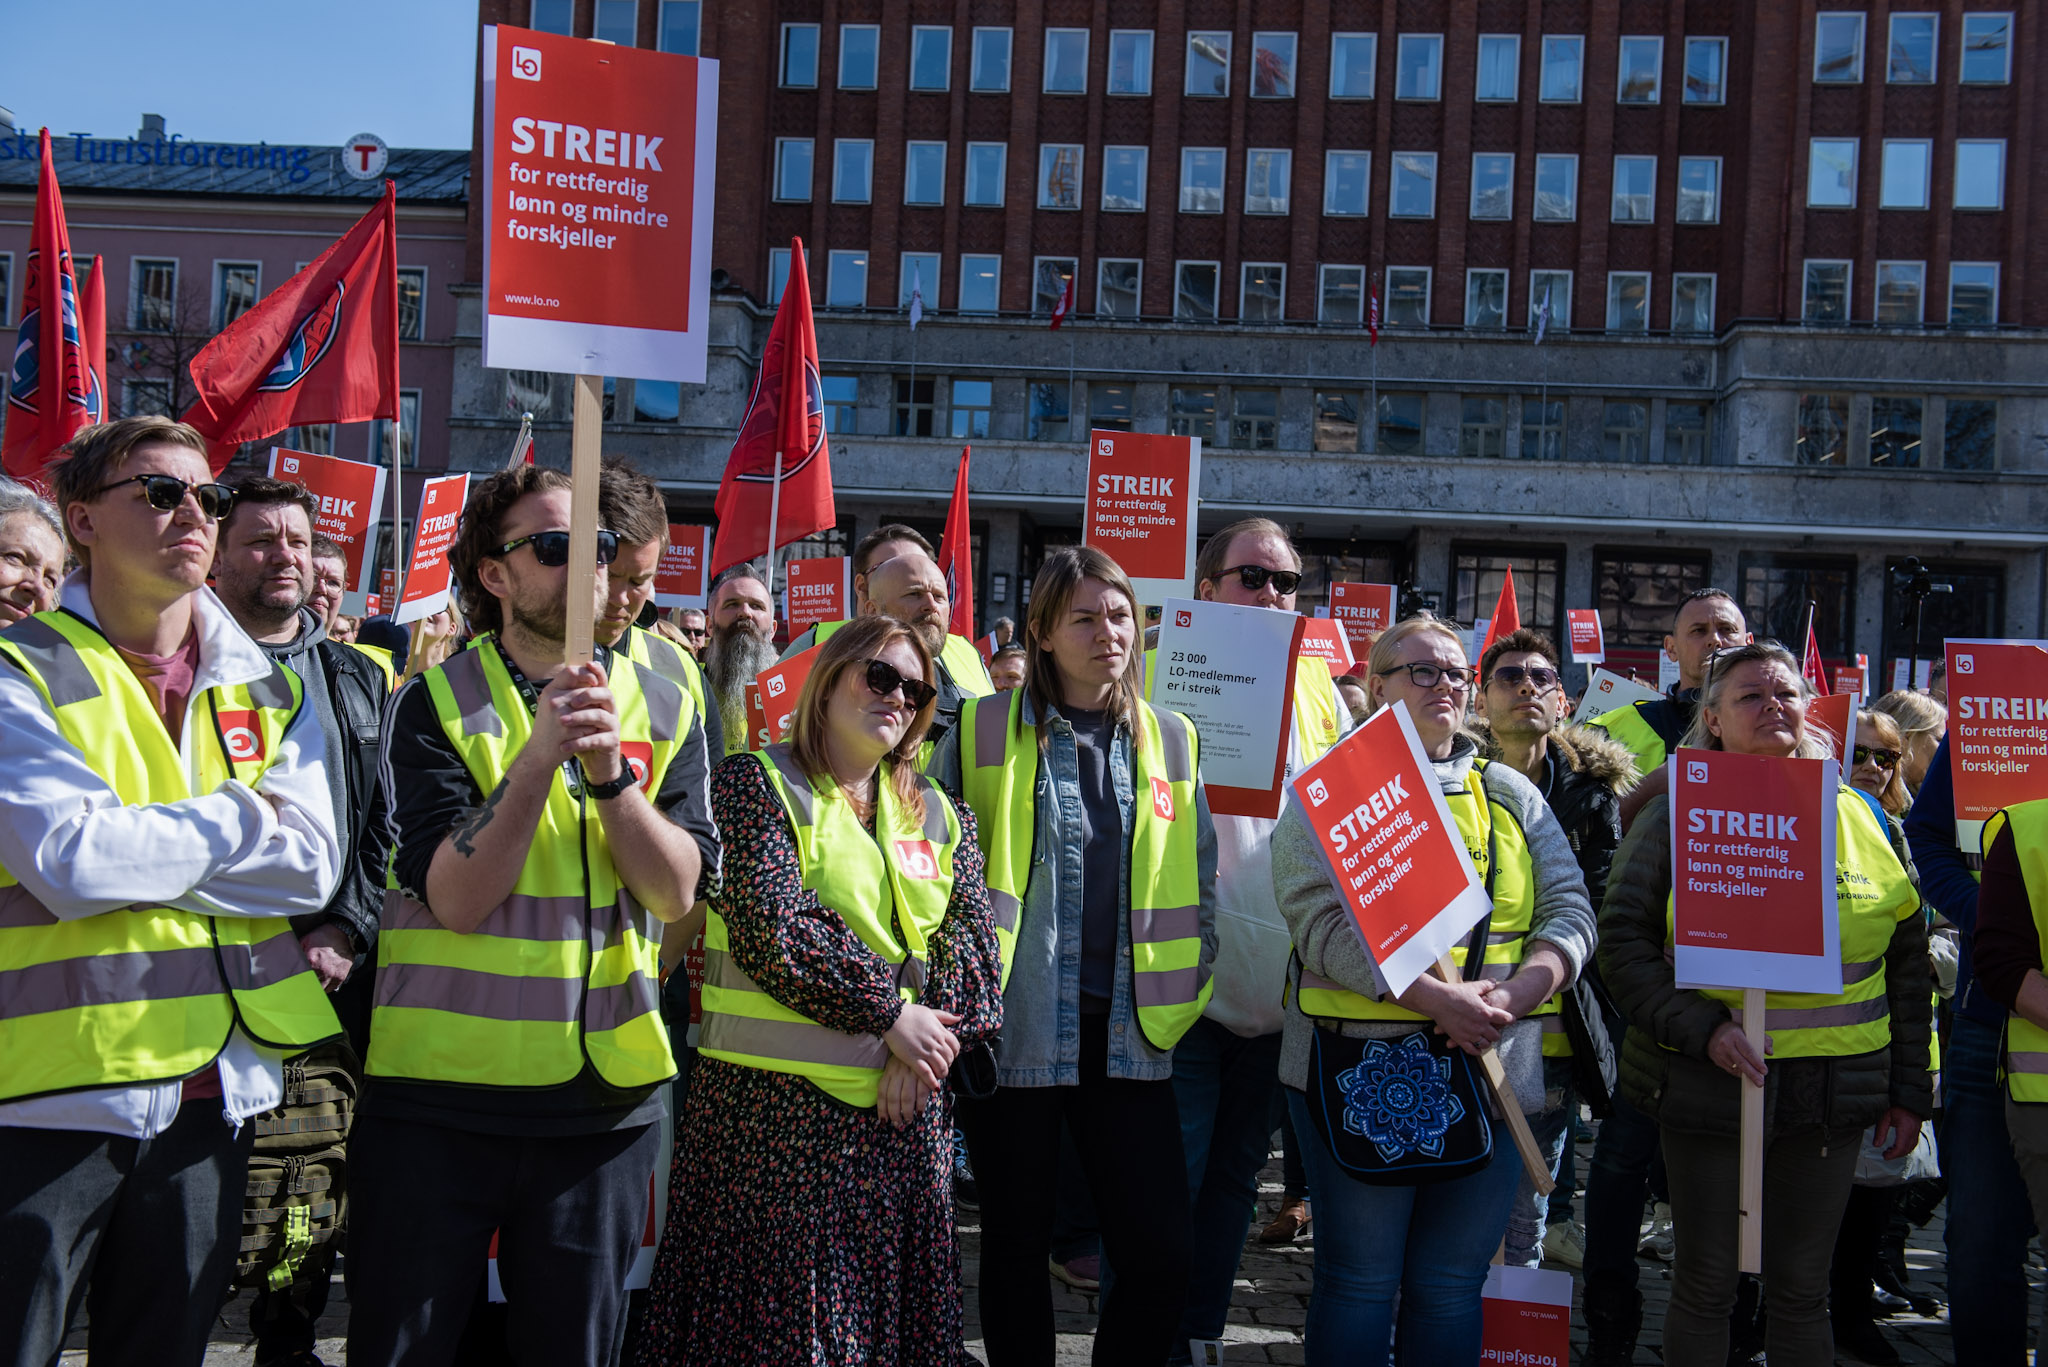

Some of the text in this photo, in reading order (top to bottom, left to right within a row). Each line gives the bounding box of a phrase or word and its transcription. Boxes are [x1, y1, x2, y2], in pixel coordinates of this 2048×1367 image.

[510, 116, 665, 172] STREIK
[69, 132, 312, 183] Turistforening
[509, 162, 649, 202] for rettferdig
[508, 190, 669, 228] lønn og mindre
[507, 219, 617, 250] forskjeller
[504, 293, 560, 308] www.lo.no
[1097, 474, 1175, 497] STREIK
[1096, 497, 1167, 514] for rettferdig
[422, 511, 457, 535] STREIK
[1095, 511, 1176, 526] lønn og mindre
[1095, 525, 1151, 541] forskjeller
[668, 545, 696, 556] REIK
[792, 584, 835, 597] STREIK
[802, 598, 831, 606] rettferdig
[1335, 606, 1381, 619] STREIK
[1345, 619, 1376, 627] rettferdig
[1171, 651, 1207, 664] 23 000
[1302, 650, 1335, 658] rettferdig
[1169, 665, 1257, 685] LO-medlemmer
[1167, 682, 1179, 691] er
[1188, 683, 1222, 695] streik
[1589, 706, 1599, 715] 23
[1959, 724, 2048, 741] for rettferdig
[1961, 742, 1990, 755] lønn
[1993, 745, 2010, 758] og
[1961, 759, 2030, 775] forskjeller
[1329, 773, 1410, 853] STREIK
[1687, 807, 1799, 842] STREIK
[1342, 808, 1414, 873] for rettferdig
[1349, 819, 1430, 891] lønn og mindre
[1687, 839, 1789, 864] for rettferdig
[1688, 858, 1805, 881] lønn og mindre
[1359, 857, 1415, 909] forskjeller
[1688, 878, 1767, 898] forskjeller
[1379, 922, 1409, 951] www.lo.no
[1687, 929, 1728, 940] www.lo.no
